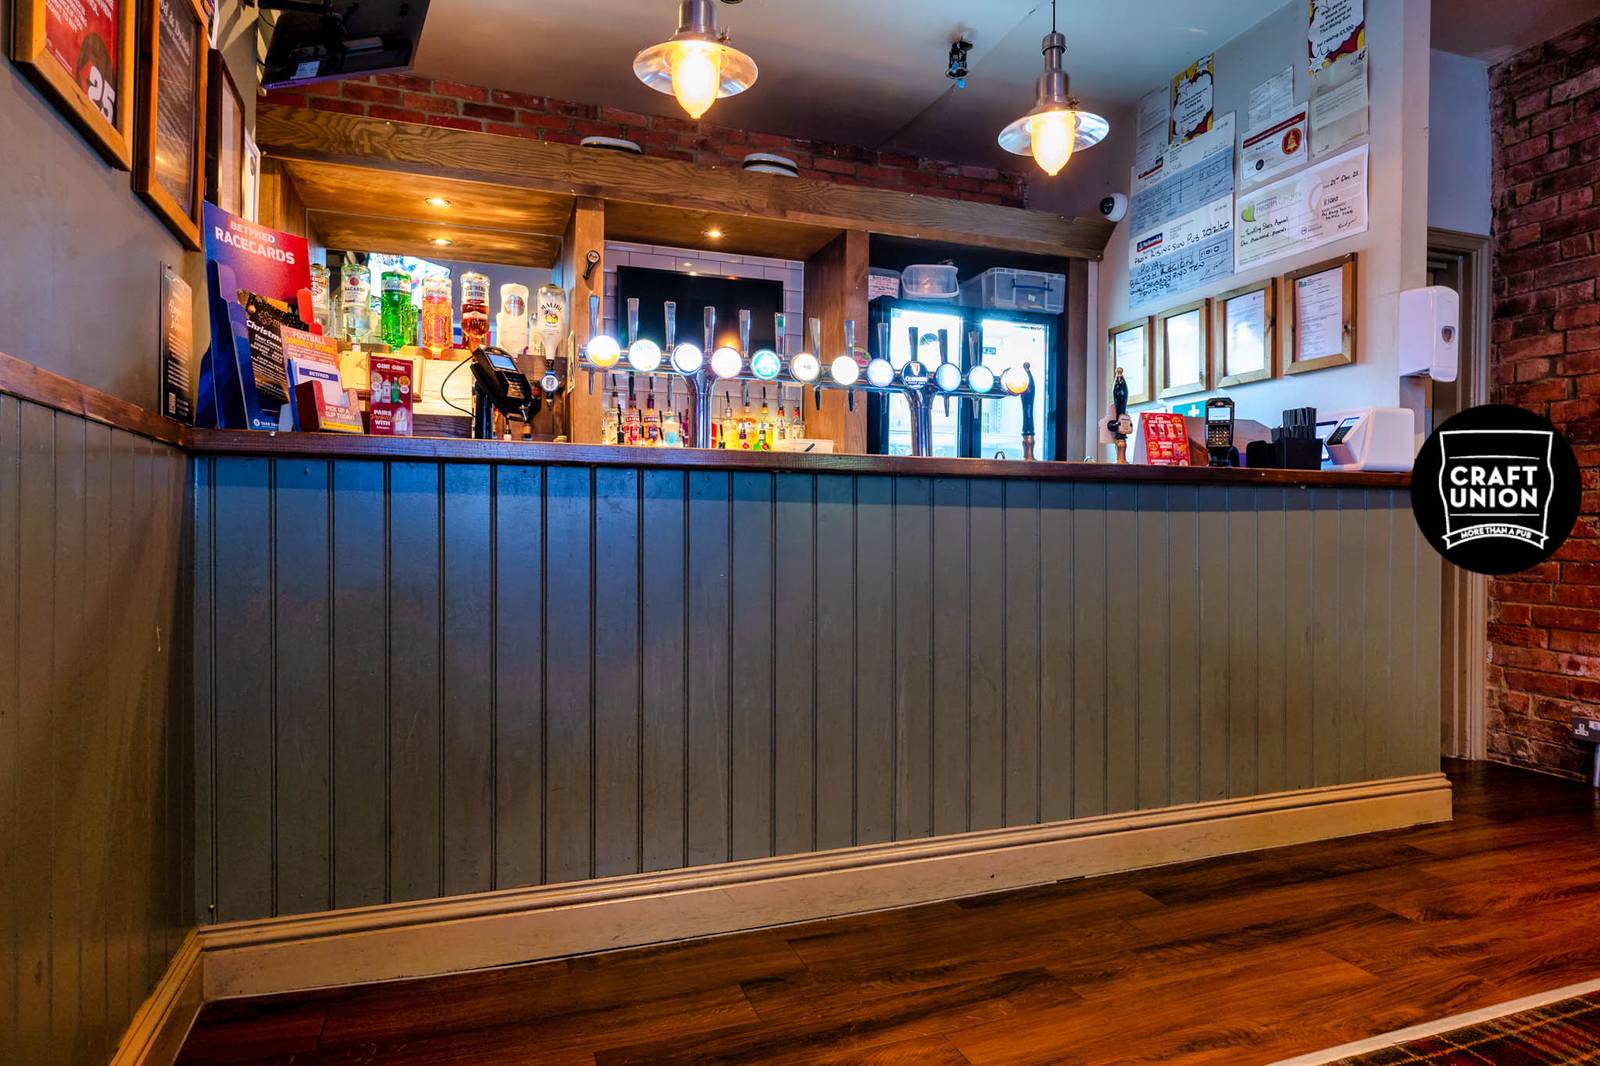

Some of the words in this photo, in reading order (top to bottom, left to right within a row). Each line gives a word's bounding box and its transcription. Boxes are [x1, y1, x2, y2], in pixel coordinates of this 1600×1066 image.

[87, 65, 116, 124] 25
[214, 226, 295, 265] RACECARDS
[230, 220, 276, 244] BETFRED
